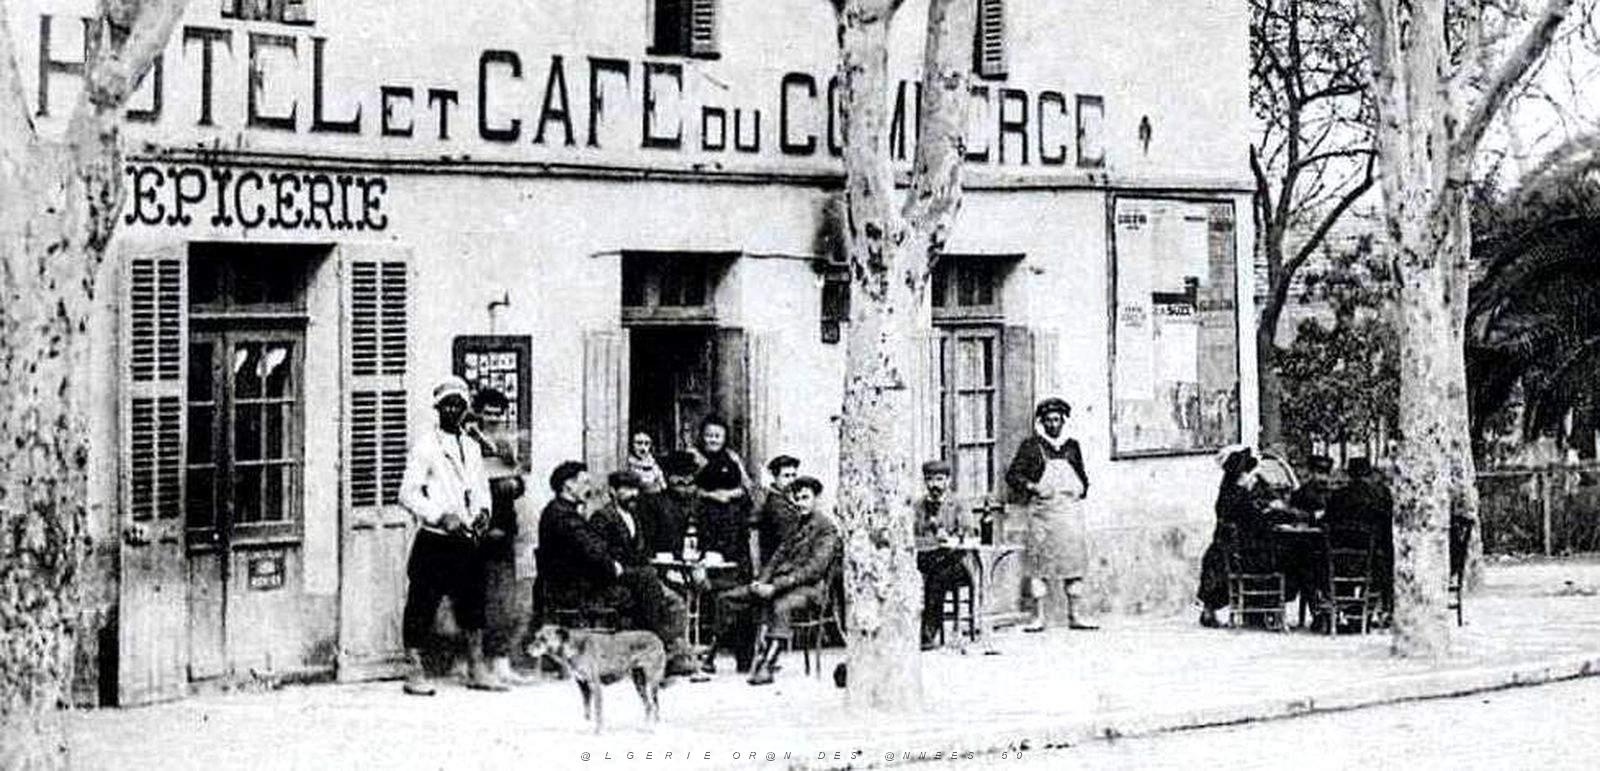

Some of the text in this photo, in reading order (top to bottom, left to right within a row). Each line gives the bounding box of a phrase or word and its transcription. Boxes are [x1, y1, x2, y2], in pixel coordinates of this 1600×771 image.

[380, 86, 459, 140] ET
[479, 49, 683, 148] CAFE
[702, 106, 760, 153] DU
[780, 72, 1105, 168] CMRCE
[125, 166, 388, 231] EPICERIE
